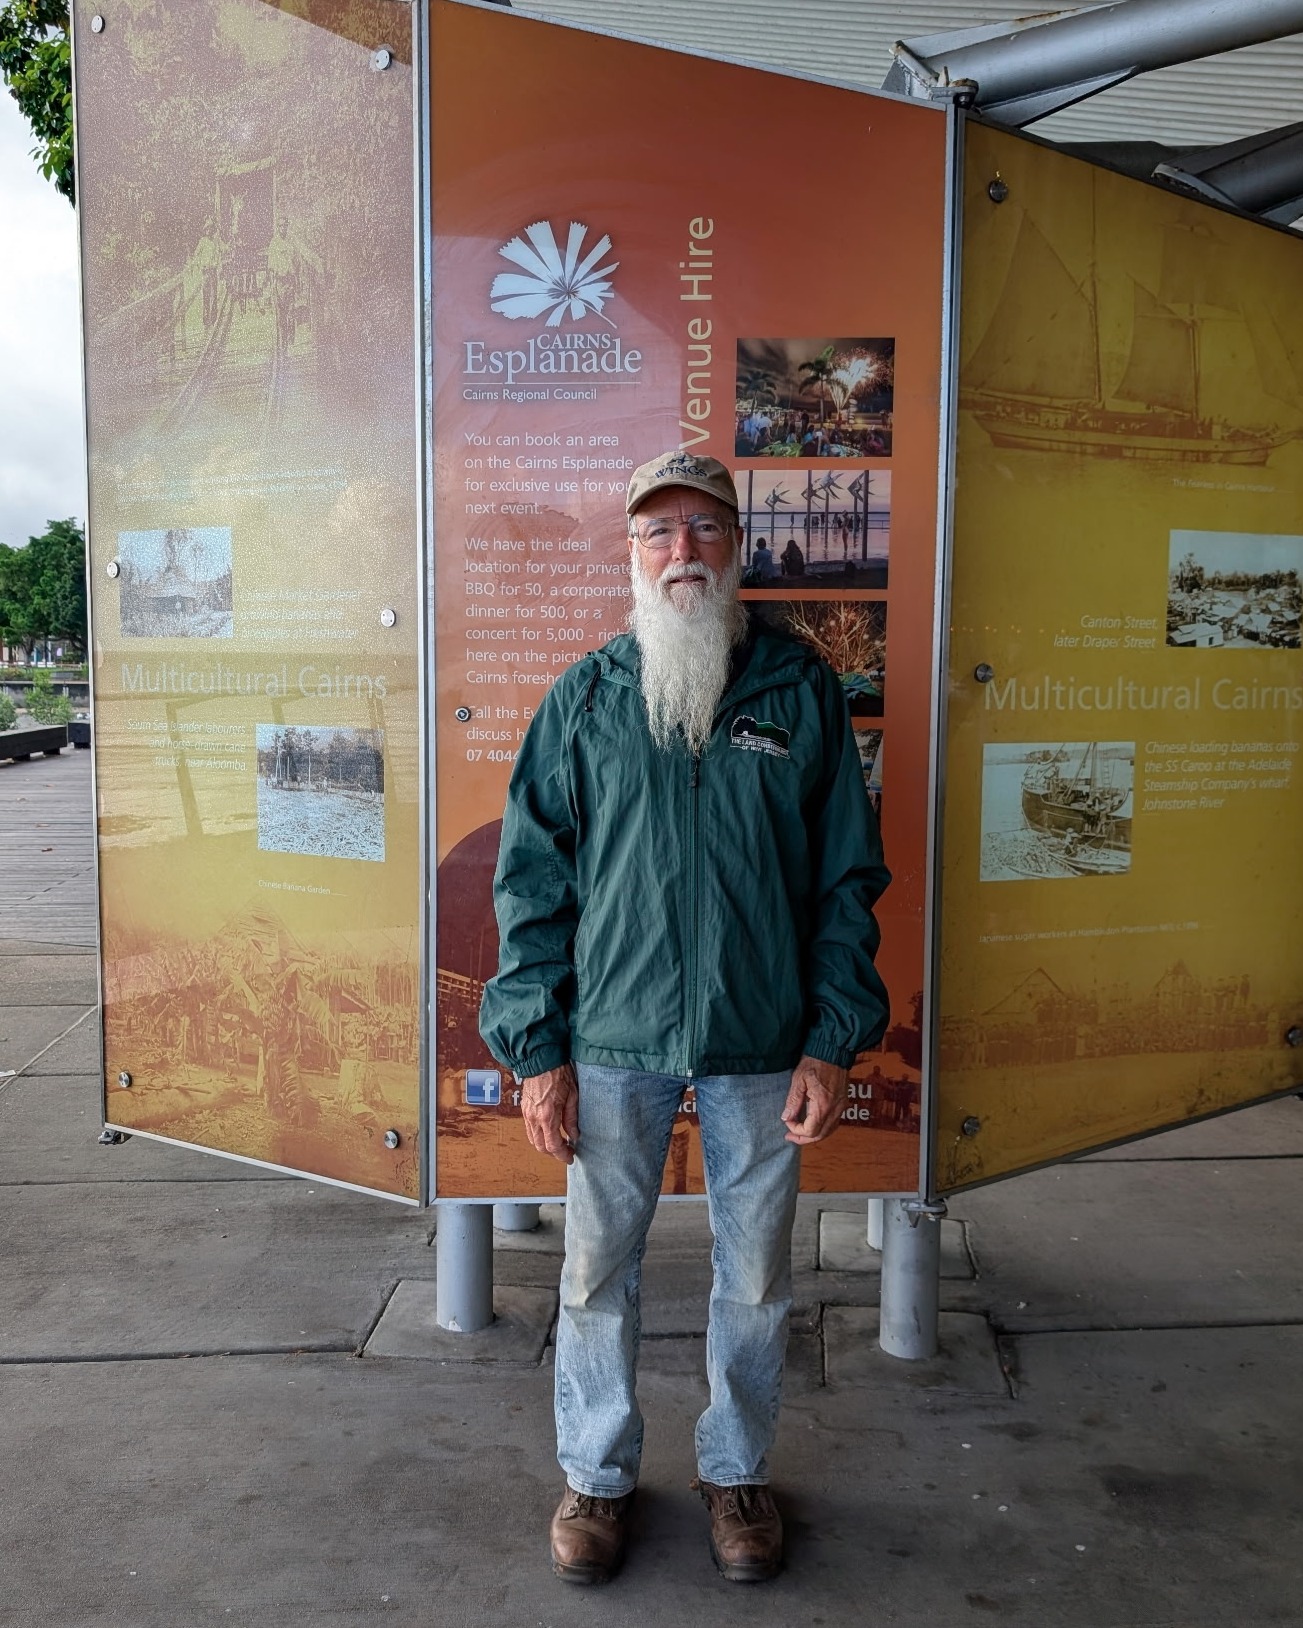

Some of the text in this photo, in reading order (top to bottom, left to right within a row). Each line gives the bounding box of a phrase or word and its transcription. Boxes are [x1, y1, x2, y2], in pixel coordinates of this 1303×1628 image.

[679, 217, 714, 450] Venue Hire
[536, 333, 611, 350] CAIRNS
[463, 338, 642, 384] Esplanade
[463, 388, 597, 403] Cairns Regional Council
[464, 432, 619, 446] You can book an area
[464, 455, 633, 472] on the Cairns Esplanade
[655, 465, 707, 479] WINGS
[464, 478, 485, 491] for
[489, 478, 550, 492] exclusive
[555, 481, 578, 492] use
[583, 478, 603, 492] for
[465, 502, 543, 514] next event.
[464, 537, 591, 551] We have the ideal
[465, 559, 520, 573] location
[526, 559, 546, 573] for
[550, 563, 581, 576] your
[465, 581, 630, 599] BBQ for 50, a corporate
[465, 604, 602, 620] dinner for 500, or a
[1081, 615, 1121, 628] Canton
[465, 628, 517, 640] concert
[521, 627, 541, 640] for
[546, 628, 584, 642] 5,000
[1054, 634, 1157, 649] later Draper Street
[466, 648, 587, 666] here on the pictu
[120, 662, 387, 699] Multicultural Cairns
[466, 671, 508, 684] Cairns
[984, 677, 1303, 711] Multicultural Cairns
[495, 706, 518, 719] the
[466, 727, 511, 741] discuss
[149, 736, 165, 748] and
[1145, 741, 1299, 756] Chinese loading bananas onto
[466, 749, 482, 762] 07
[1144, 761, 1162, 773] the
[1165, 760, 1179, 773] SS
[1214, 761, 1226, 771] at
[1228, 759, 1245, 771] the
[1248, 758, 1292, 771] Adelaide
[1143, 779, 1199, 792] Steamship
[1201, 777, 1256, 792] Company's
[1142, 797, 1226, 811] Johnstone River
[307, 885, 331, 895] Garden
